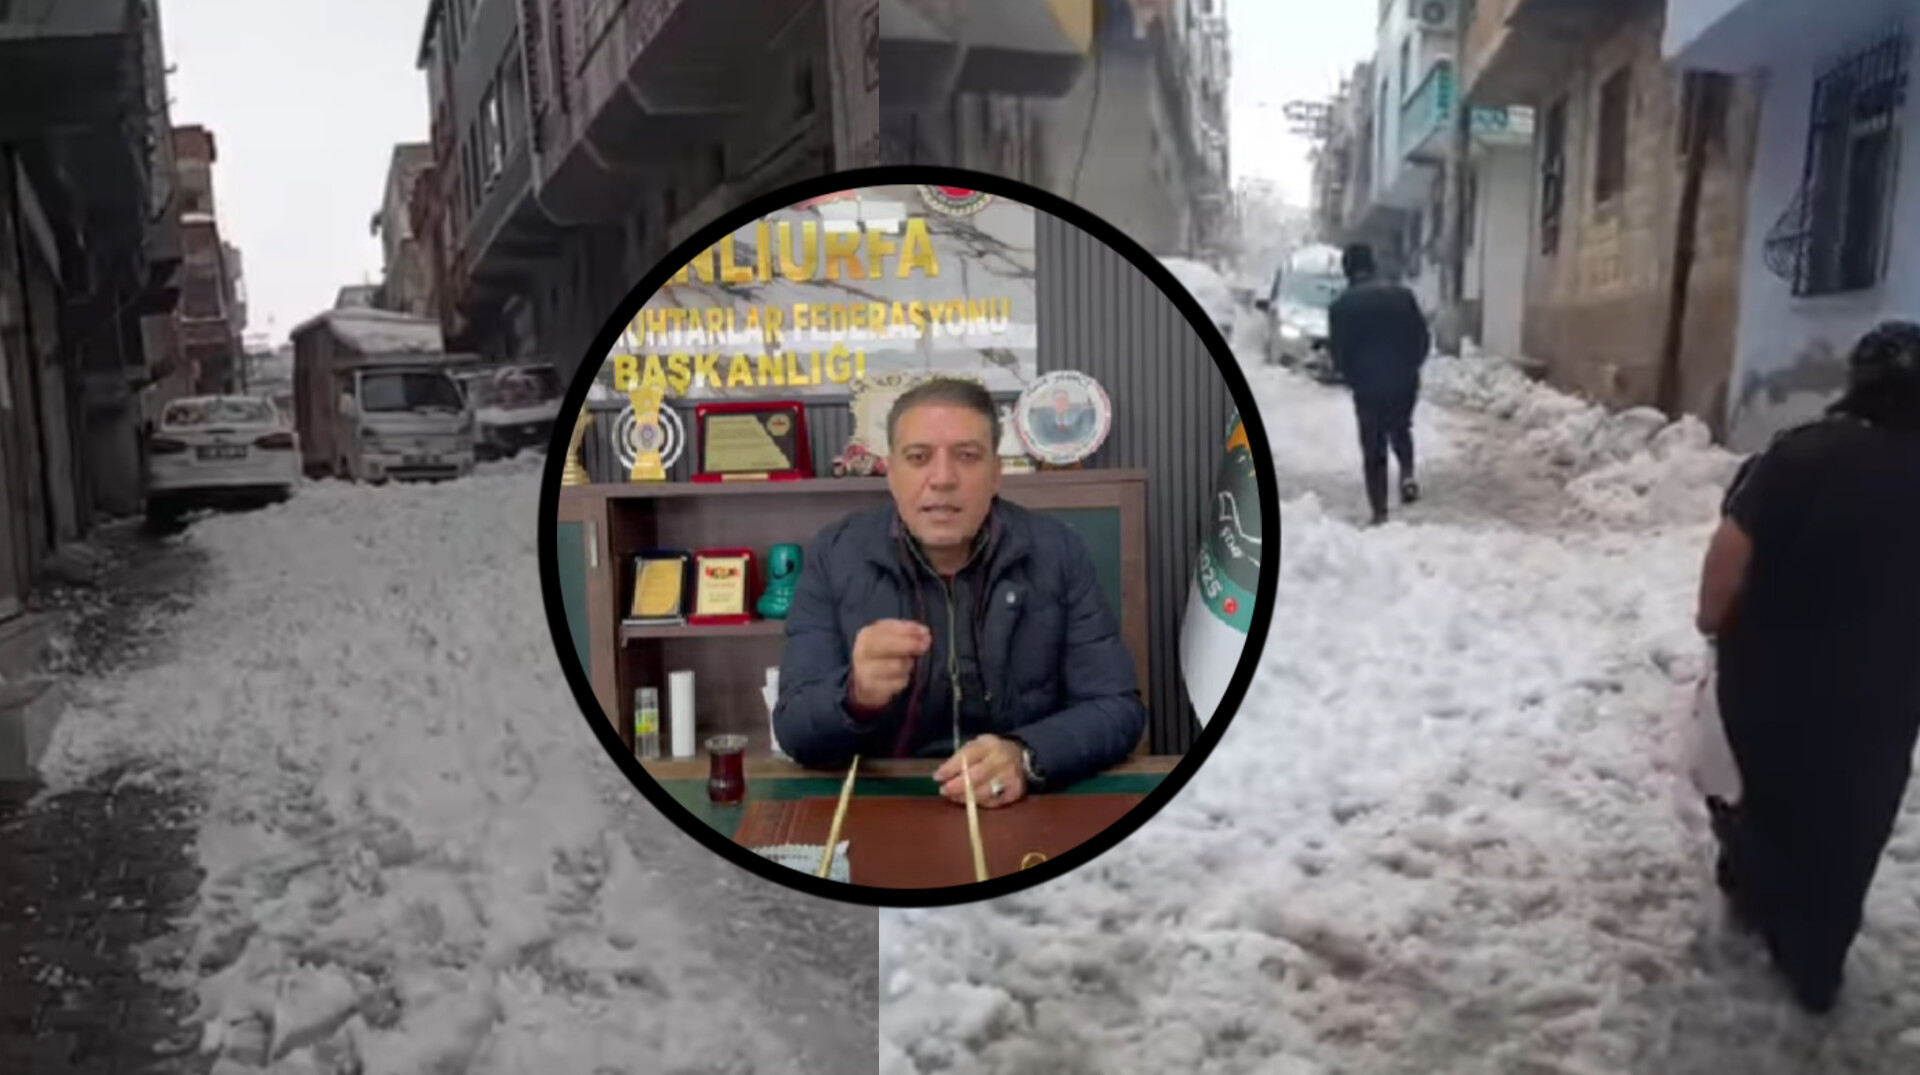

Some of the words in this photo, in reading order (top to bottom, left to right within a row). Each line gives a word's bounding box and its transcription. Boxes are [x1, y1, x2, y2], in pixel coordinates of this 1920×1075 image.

[662, 217, 940, 287] NLIURFA
[617, 305, 783, 348] UHTARLAR
[793, 297, 1012, 342] FEDERASYONU
[613, 343, 867, 396] BAŞKANLIĞI
